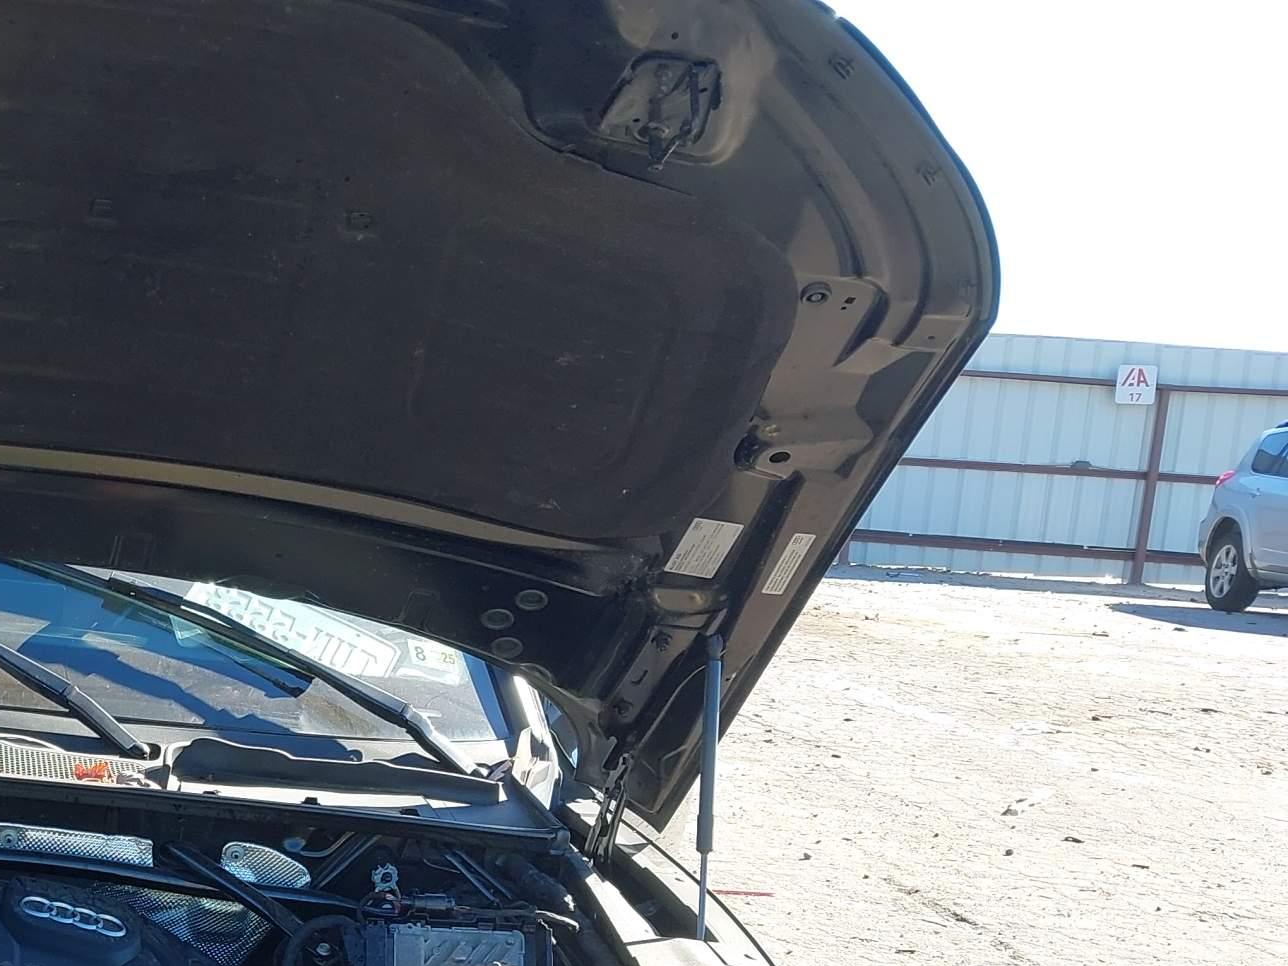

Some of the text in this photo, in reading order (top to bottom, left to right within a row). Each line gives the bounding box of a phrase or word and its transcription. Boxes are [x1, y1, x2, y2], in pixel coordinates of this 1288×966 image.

[1129, 393, 1142, 402] 17
[414, 646, 455, 664] 8 25
